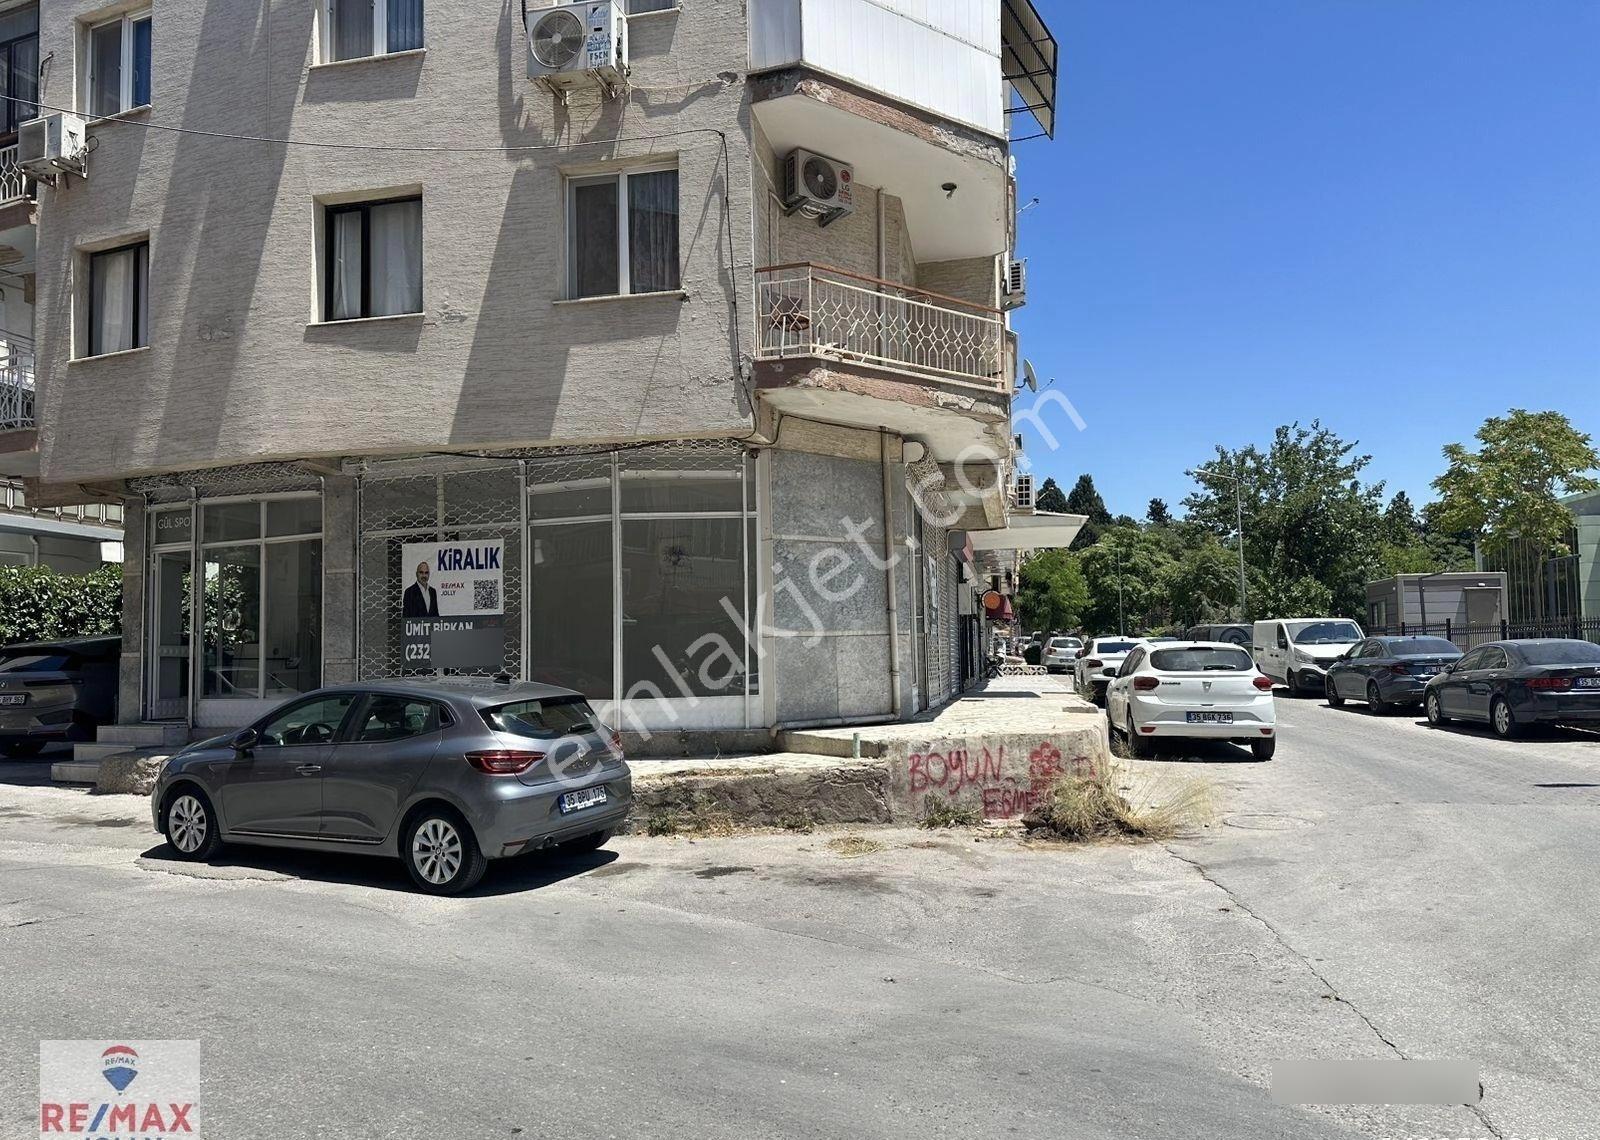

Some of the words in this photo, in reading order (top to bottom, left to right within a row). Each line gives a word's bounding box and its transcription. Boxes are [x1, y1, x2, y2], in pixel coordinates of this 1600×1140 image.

[157, 516, 173, 529] GÜL
[174, 516, 193, 528] SPO
[440, 581, 465, 590] RE/MAX
[405, 642, 432, 662] (232
[1192, 713, 1201, 721] 35
[565, 793, 576, 807] 35
